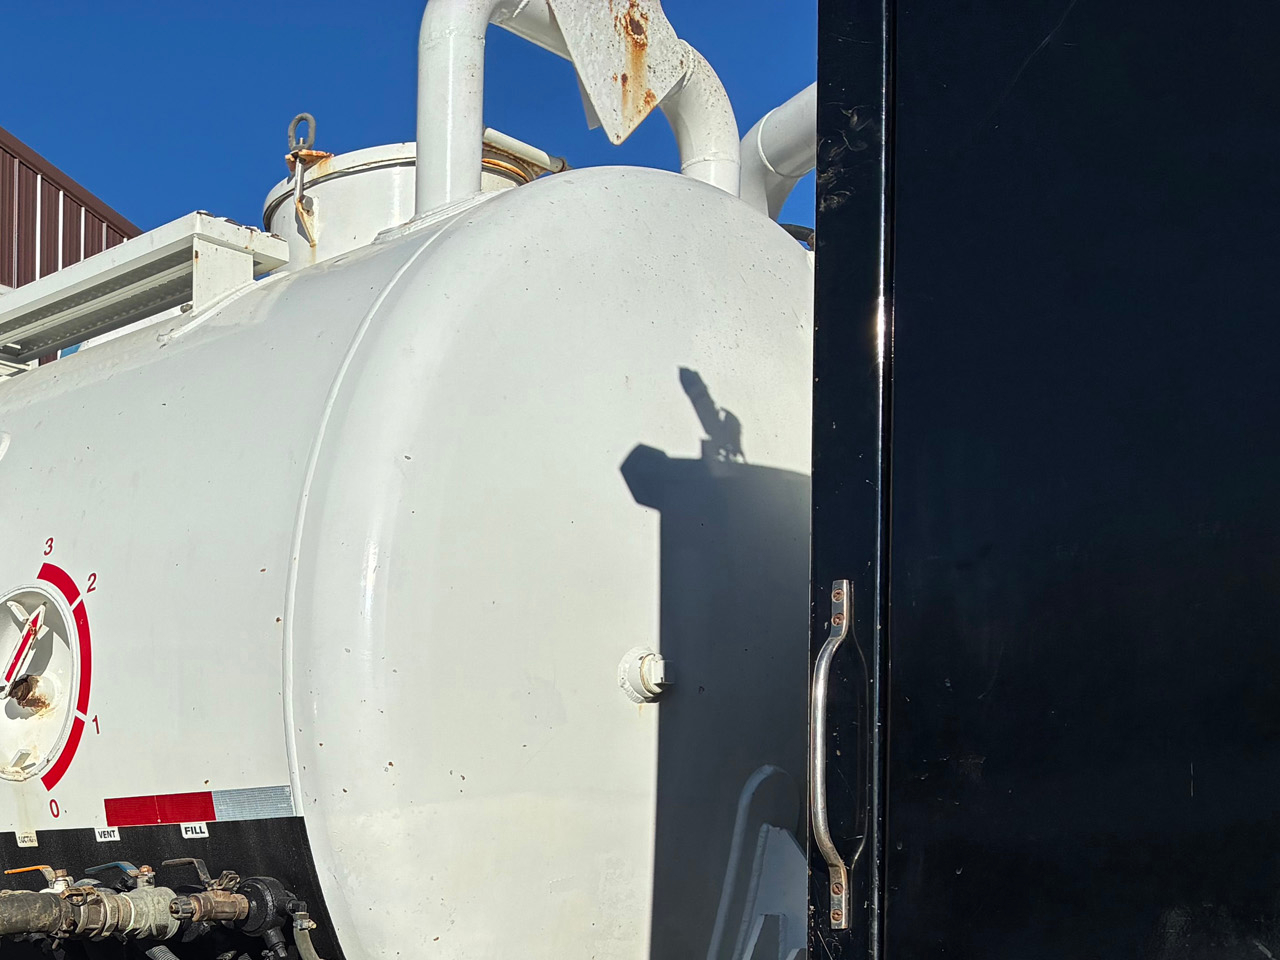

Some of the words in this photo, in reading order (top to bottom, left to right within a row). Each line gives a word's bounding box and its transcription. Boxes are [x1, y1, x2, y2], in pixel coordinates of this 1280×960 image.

[44, 537, 54, 556] 3
[86, 573, 97, 593] 2
[92, 717, 100, 735] 1
[49, 799, 60, 818] 0
[97, 830, 116, 840] VENT
[184, 826, 206, 836] FILL
